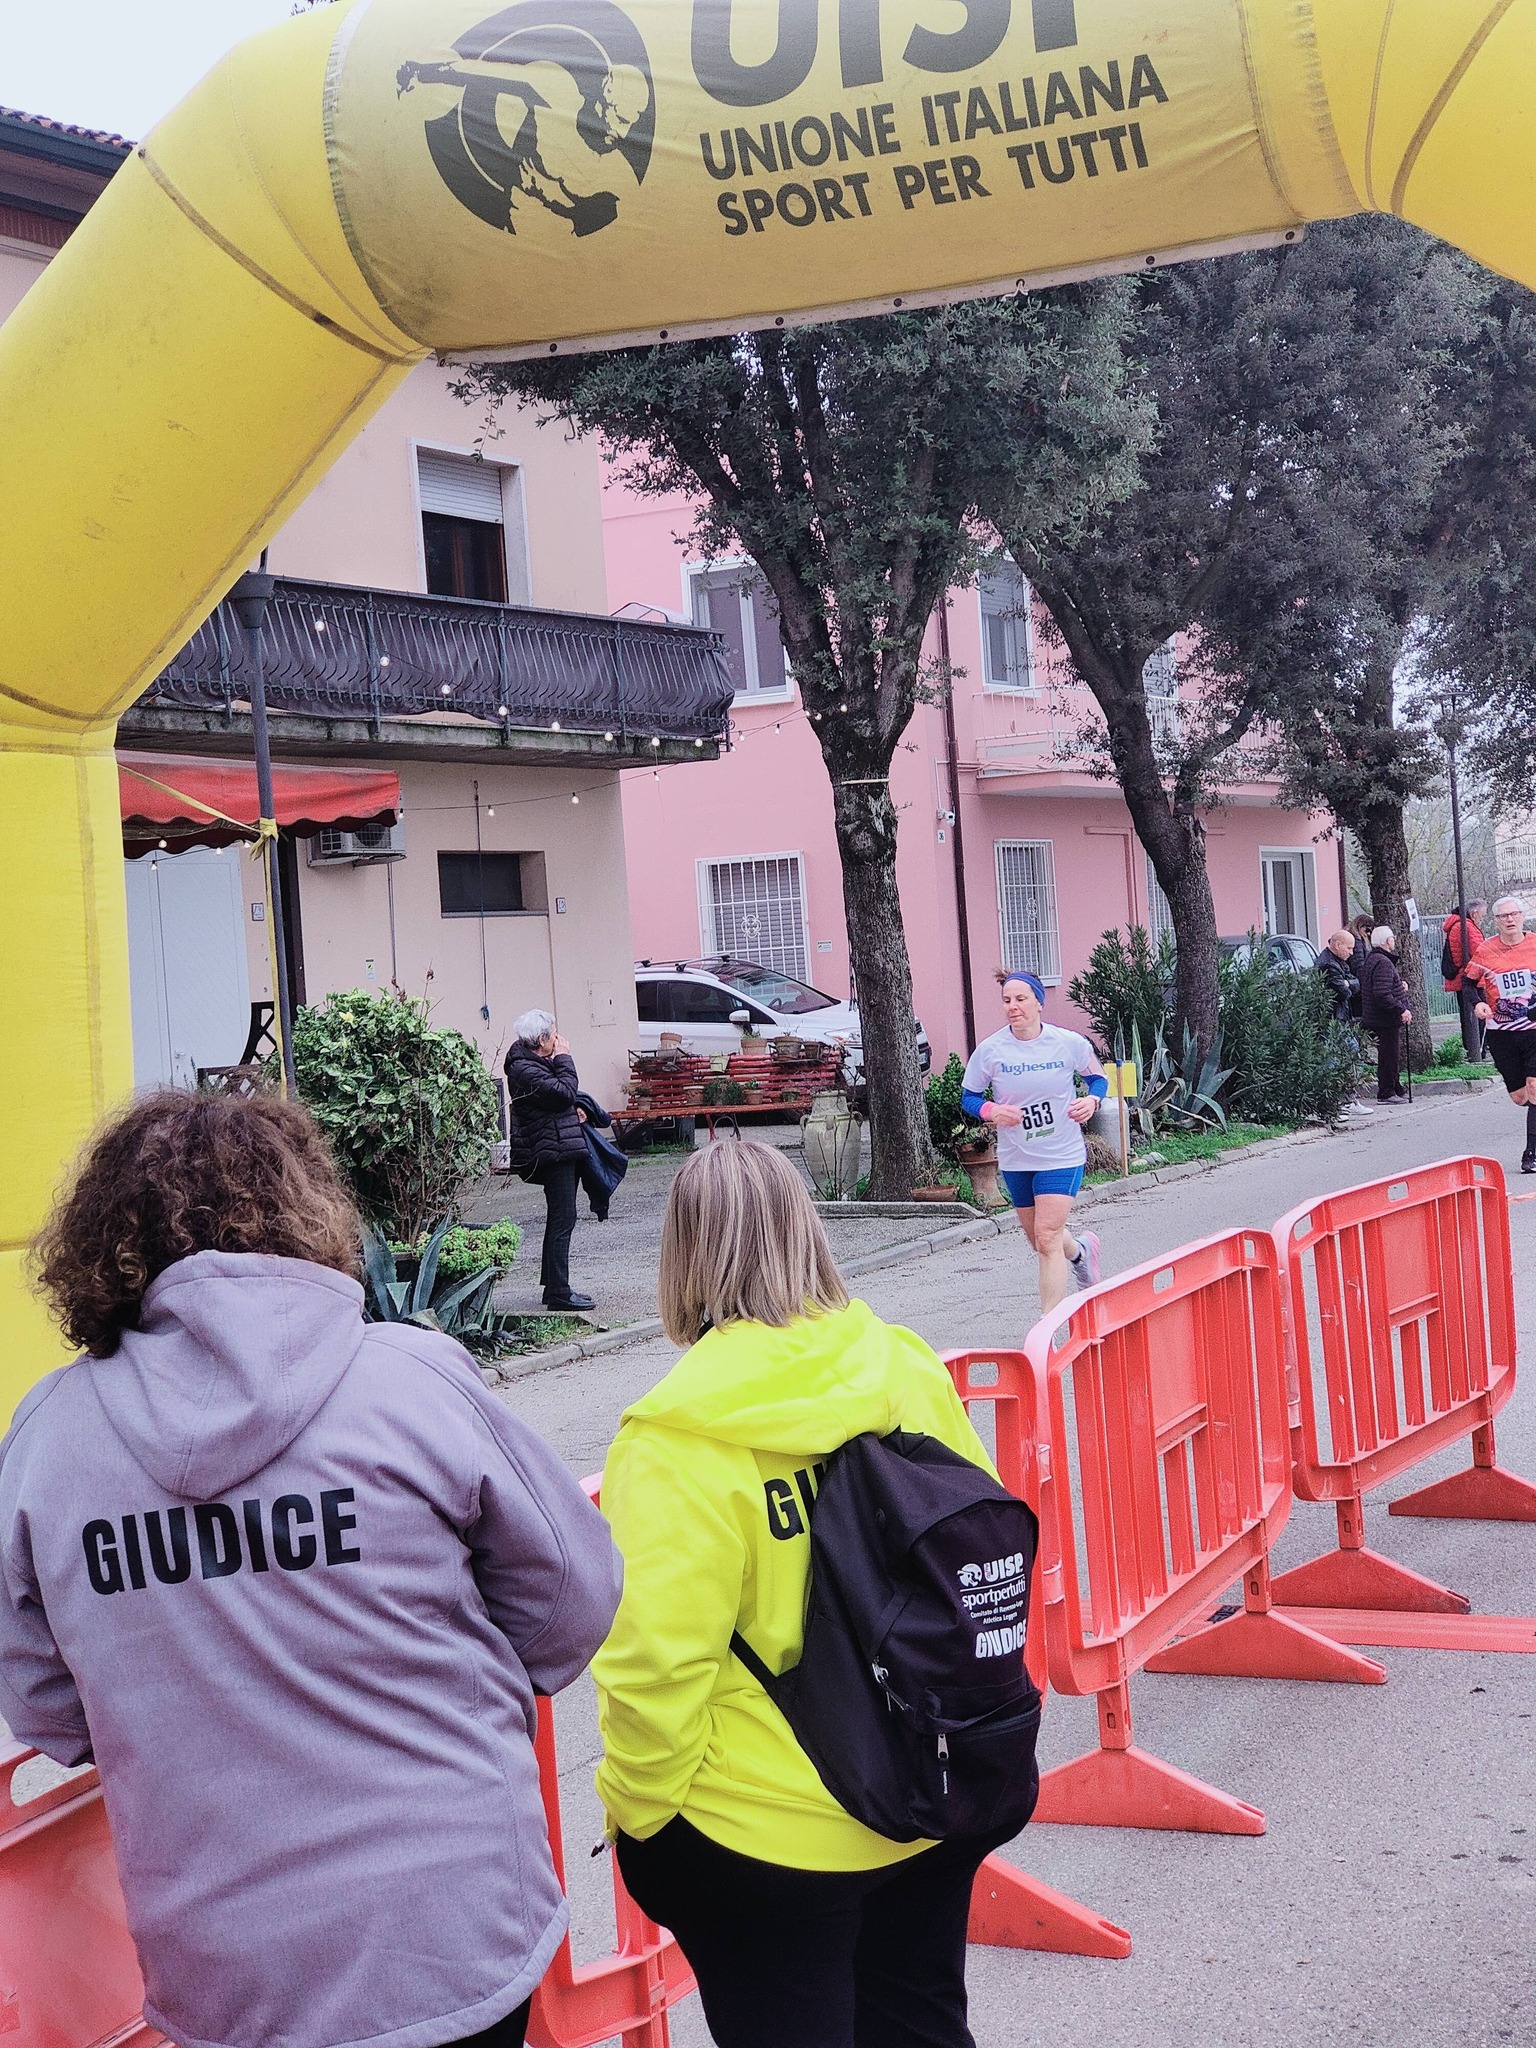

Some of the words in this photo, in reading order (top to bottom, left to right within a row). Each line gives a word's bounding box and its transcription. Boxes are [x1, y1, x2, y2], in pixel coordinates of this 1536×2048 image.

[699, 102, 902, 181] UNIONE
[921, 54, 1169, 147] ITALIANA
[717, 172, 873, 236] SPORT
[893, 154, 992, 210] PER
[1006, 122, 1149, 190] TUTTI
[1502, 970, 1526, 990] 695
[1020, 1101, 1054, 1131] 653
[82, 1487, 361, 1596] GIUDICE
[983, 1552, 1024, 1583] UISP
[961, 1576, 1026, 1611] sportpertutti
